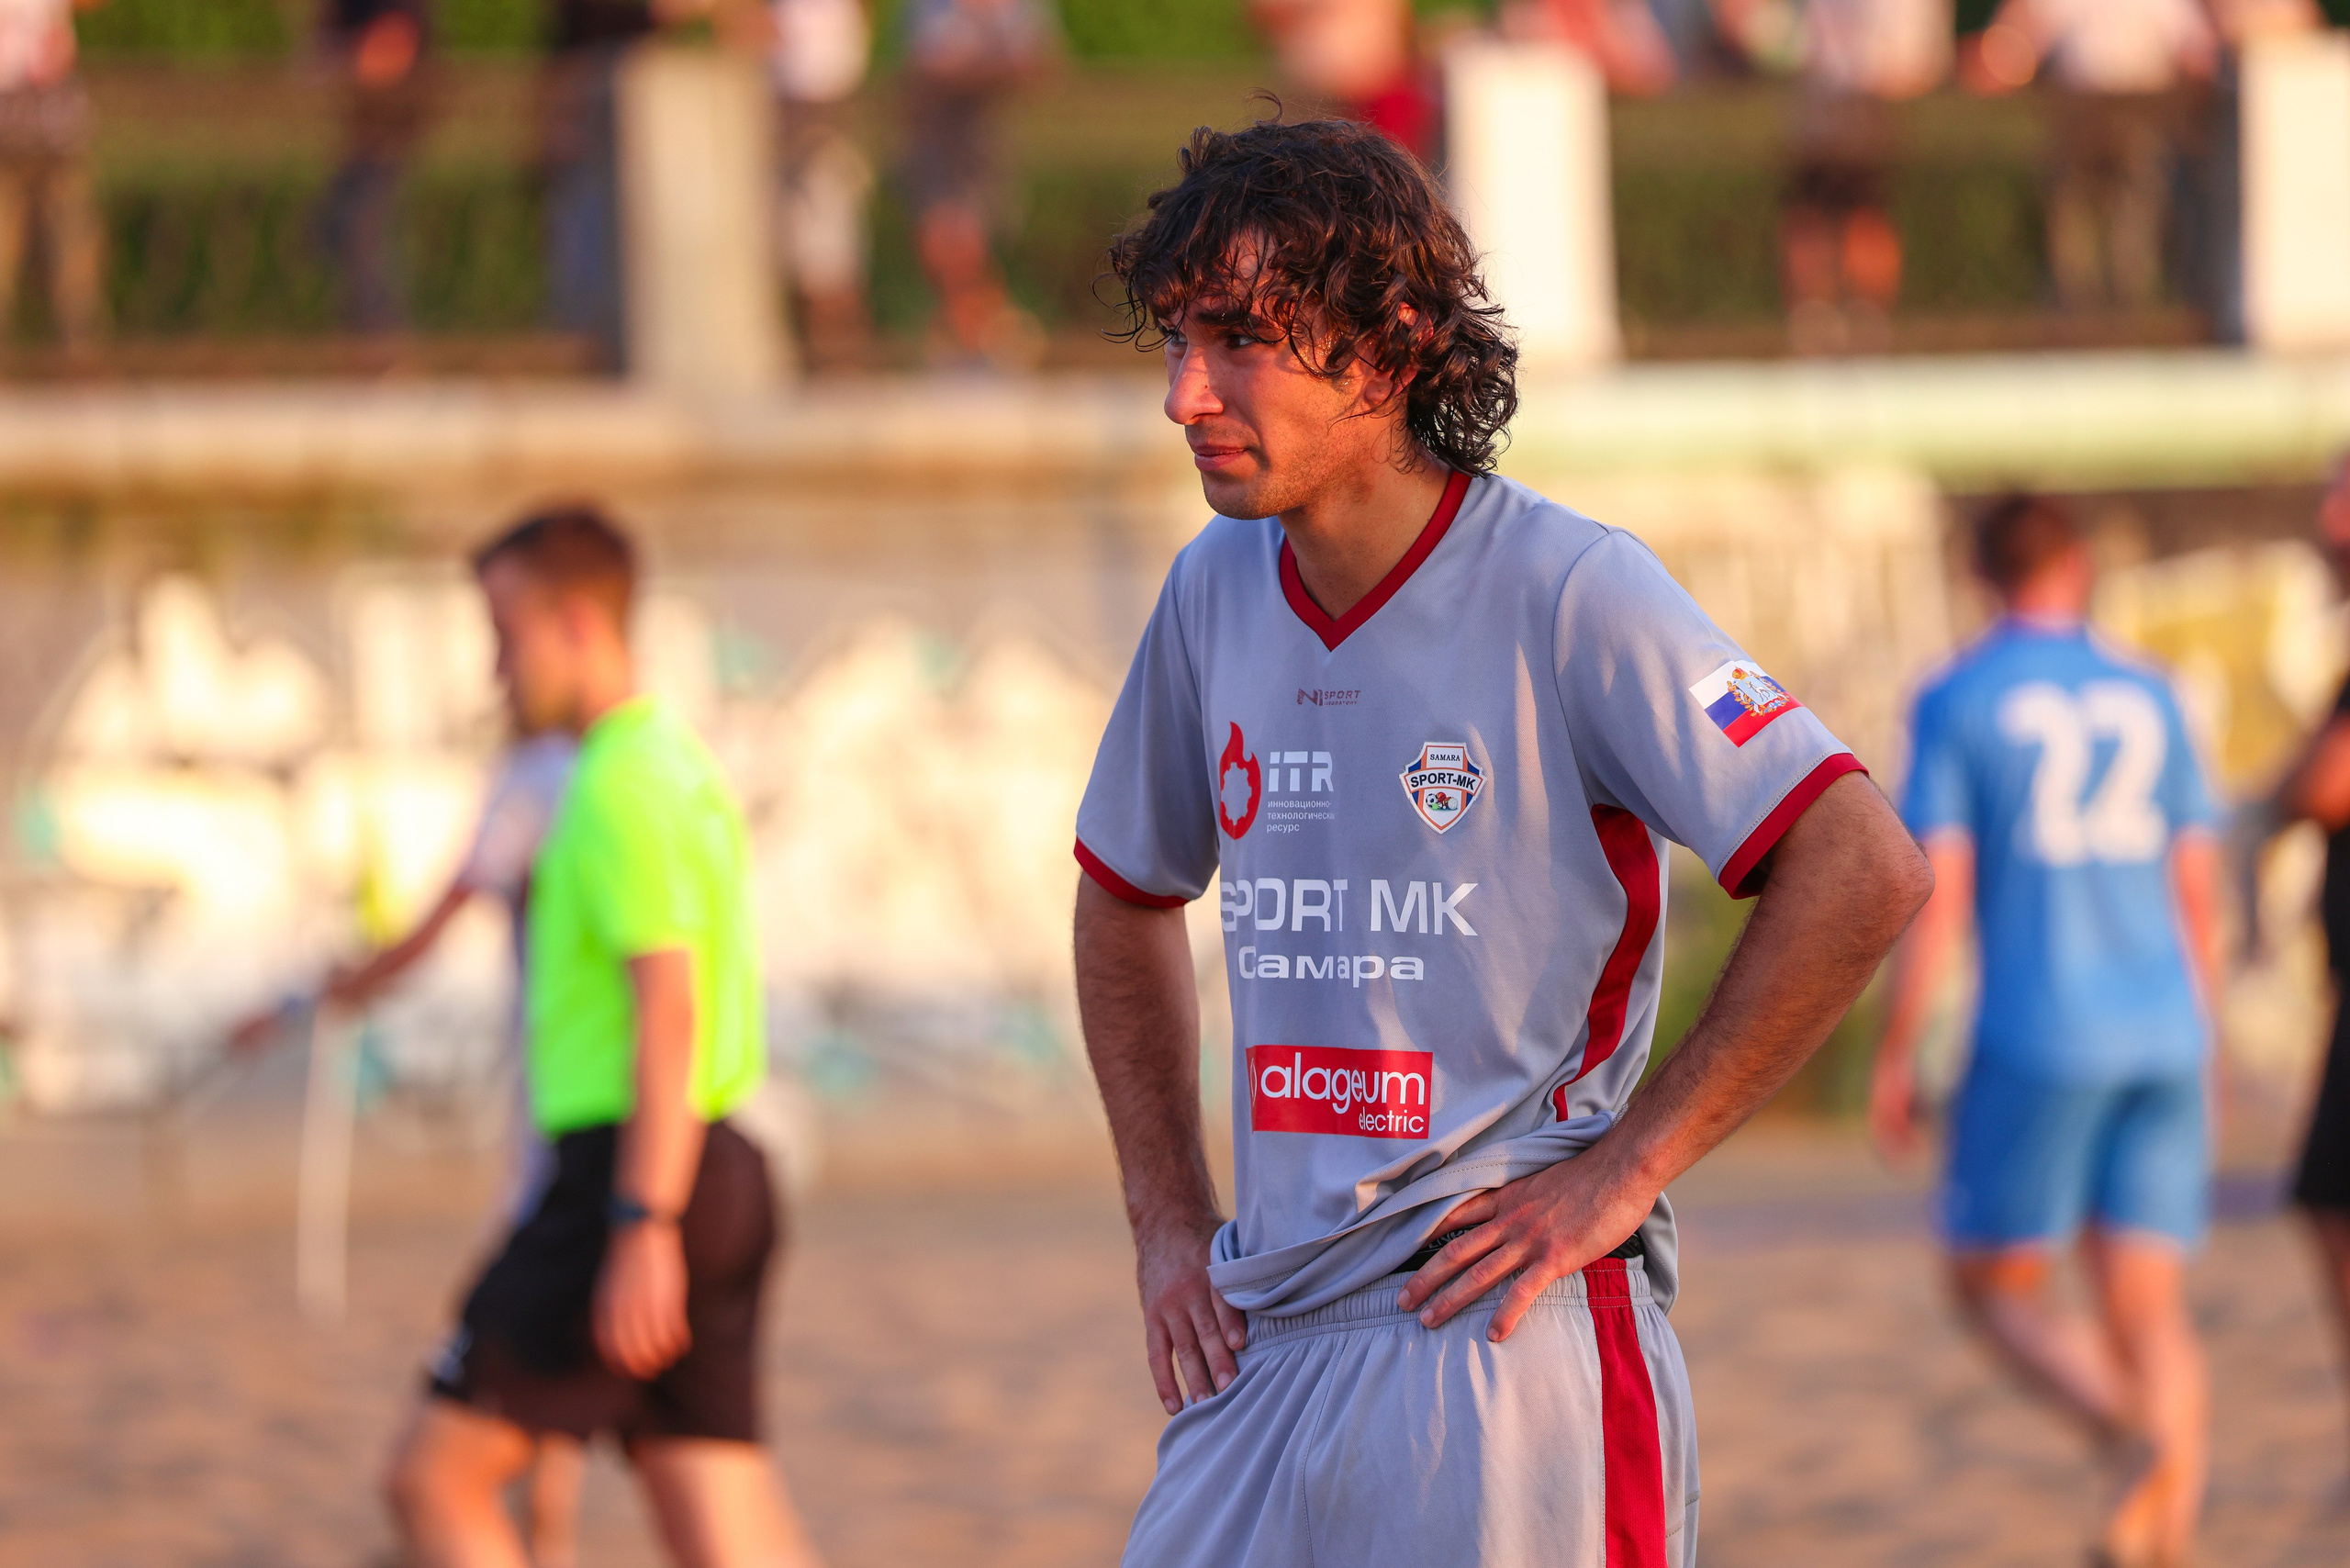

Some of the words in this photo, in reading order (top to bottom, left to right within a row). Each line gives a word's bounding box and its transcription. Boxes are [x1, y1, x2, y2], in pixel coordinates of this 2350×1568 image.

[1324, 689, 1361, 700] SPORT
[1429, 754, 1460, 762] SAMARA
[1410, 772, 1476, 790] SPORT-MK
[1998, 681, 2168, 867] 22
[1268, 800, 1332, 810] инновационно-
[1266, 823, 1300, 834] ресурс
[1220, 877, 1348, 934] SPORT
[1370, 879, 1479, 936] MK
[1237, 945, 1425, 989] Самара
[1260, 1051, 1426, 1114] alageum
[1359, 1106, 1425, 1134] electric
